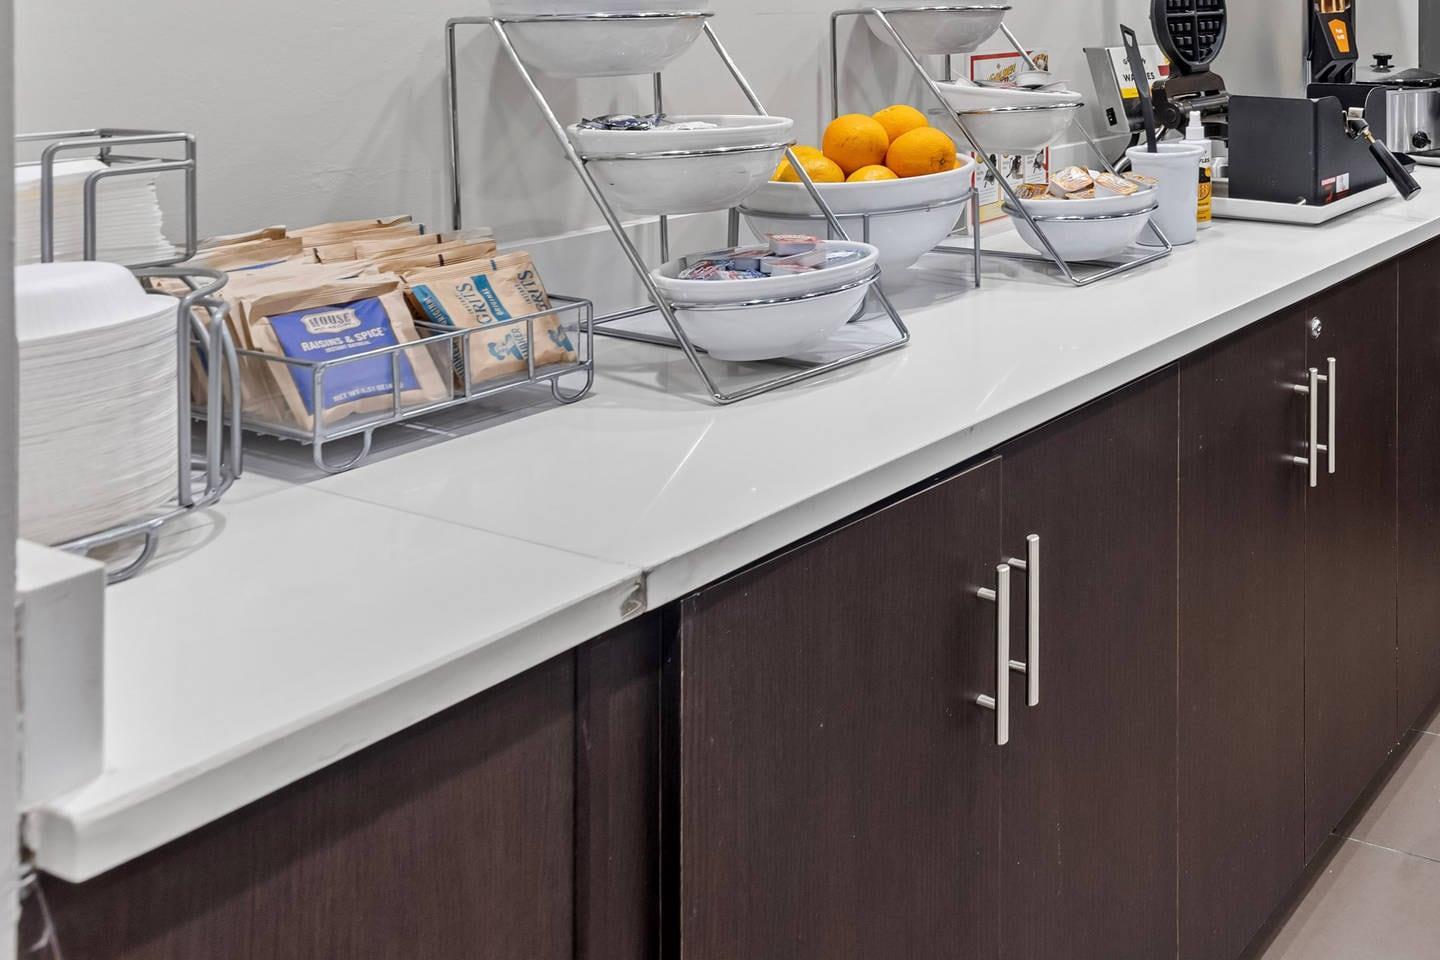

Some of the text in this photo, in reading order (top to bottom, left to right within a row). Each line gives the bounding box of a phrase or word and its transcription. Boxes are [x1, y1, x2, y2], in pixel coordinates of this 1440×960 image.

[1123, 71, 1155, 82] WAES
[456, 282, 493, 325] GRITS
[308, 311, 352, 328] HOUSE
[300, 337, 344, 352] RAISINS
[344, 335, 355, 344] &
[353, 327, 386, 343] SPICE
